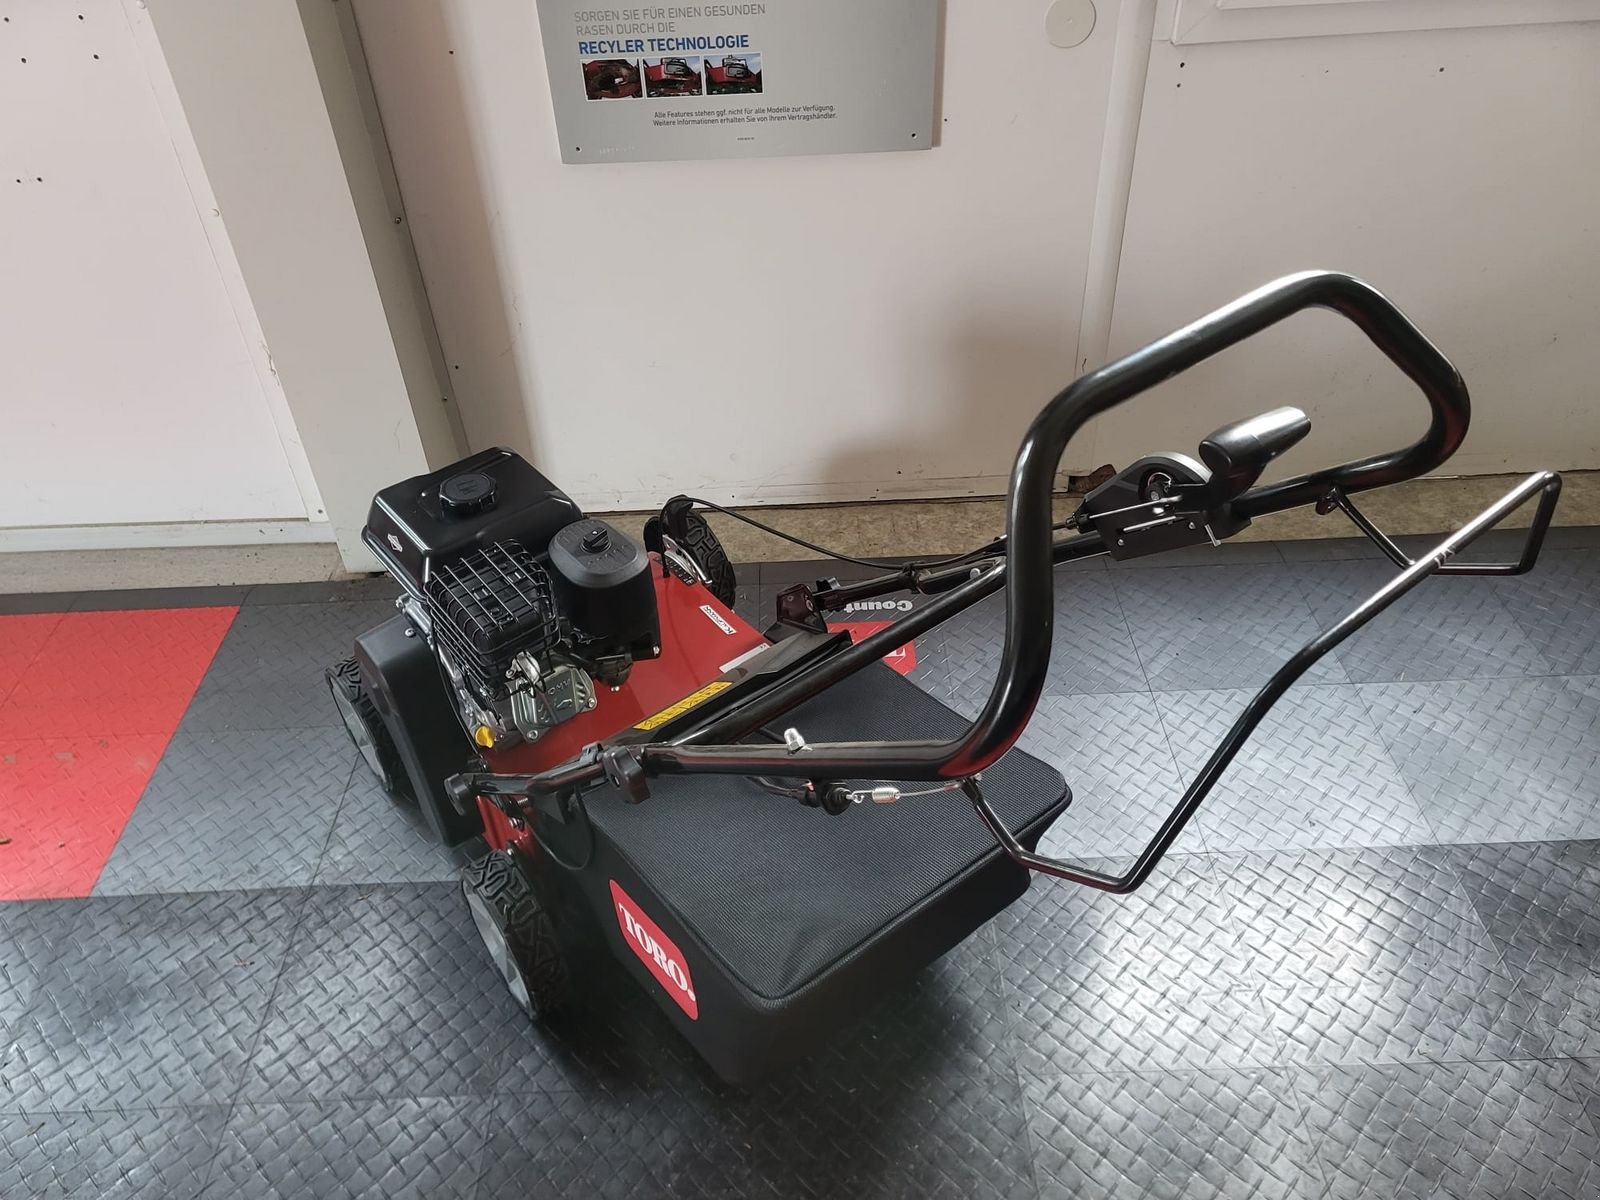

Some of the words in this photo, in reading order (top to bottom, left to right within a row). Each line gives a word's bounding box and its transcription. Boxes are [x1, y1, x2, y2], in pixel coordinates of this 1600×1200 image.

[574, 10, 620, 22] SORGEN
[622, 9, 640, 20] SIE
[642, 6, 665, 20] FÜR
[668, 6, 701, 19] EINEN
[704, 3, 766, 17] GESUNDEN
[576, 24, 614, 36] RASEN
[616, 22, 655, 35] DURCH
[657, 21, 676, 33] DIE
[578, 39, 645, 55] RECYLER
[647, 34, 750, 52] TECHNOLOGIE
[667, 110, 694, 118] Features
[694, 109, 716, 117] stehen
[728, 108, 743, 116] nicht
[744, 106, 753, 115] für
[754, 106, 766, 114] alle
[766, 106, 791, 114] Modelle
[652, 119, 676, 127] Weitere
[677, 117, 720, 126] Informationen
[719, 115, 745, 124] erhalten
[745, 115, 756, 123] Sie
[843, 600, 913, 613] Count
